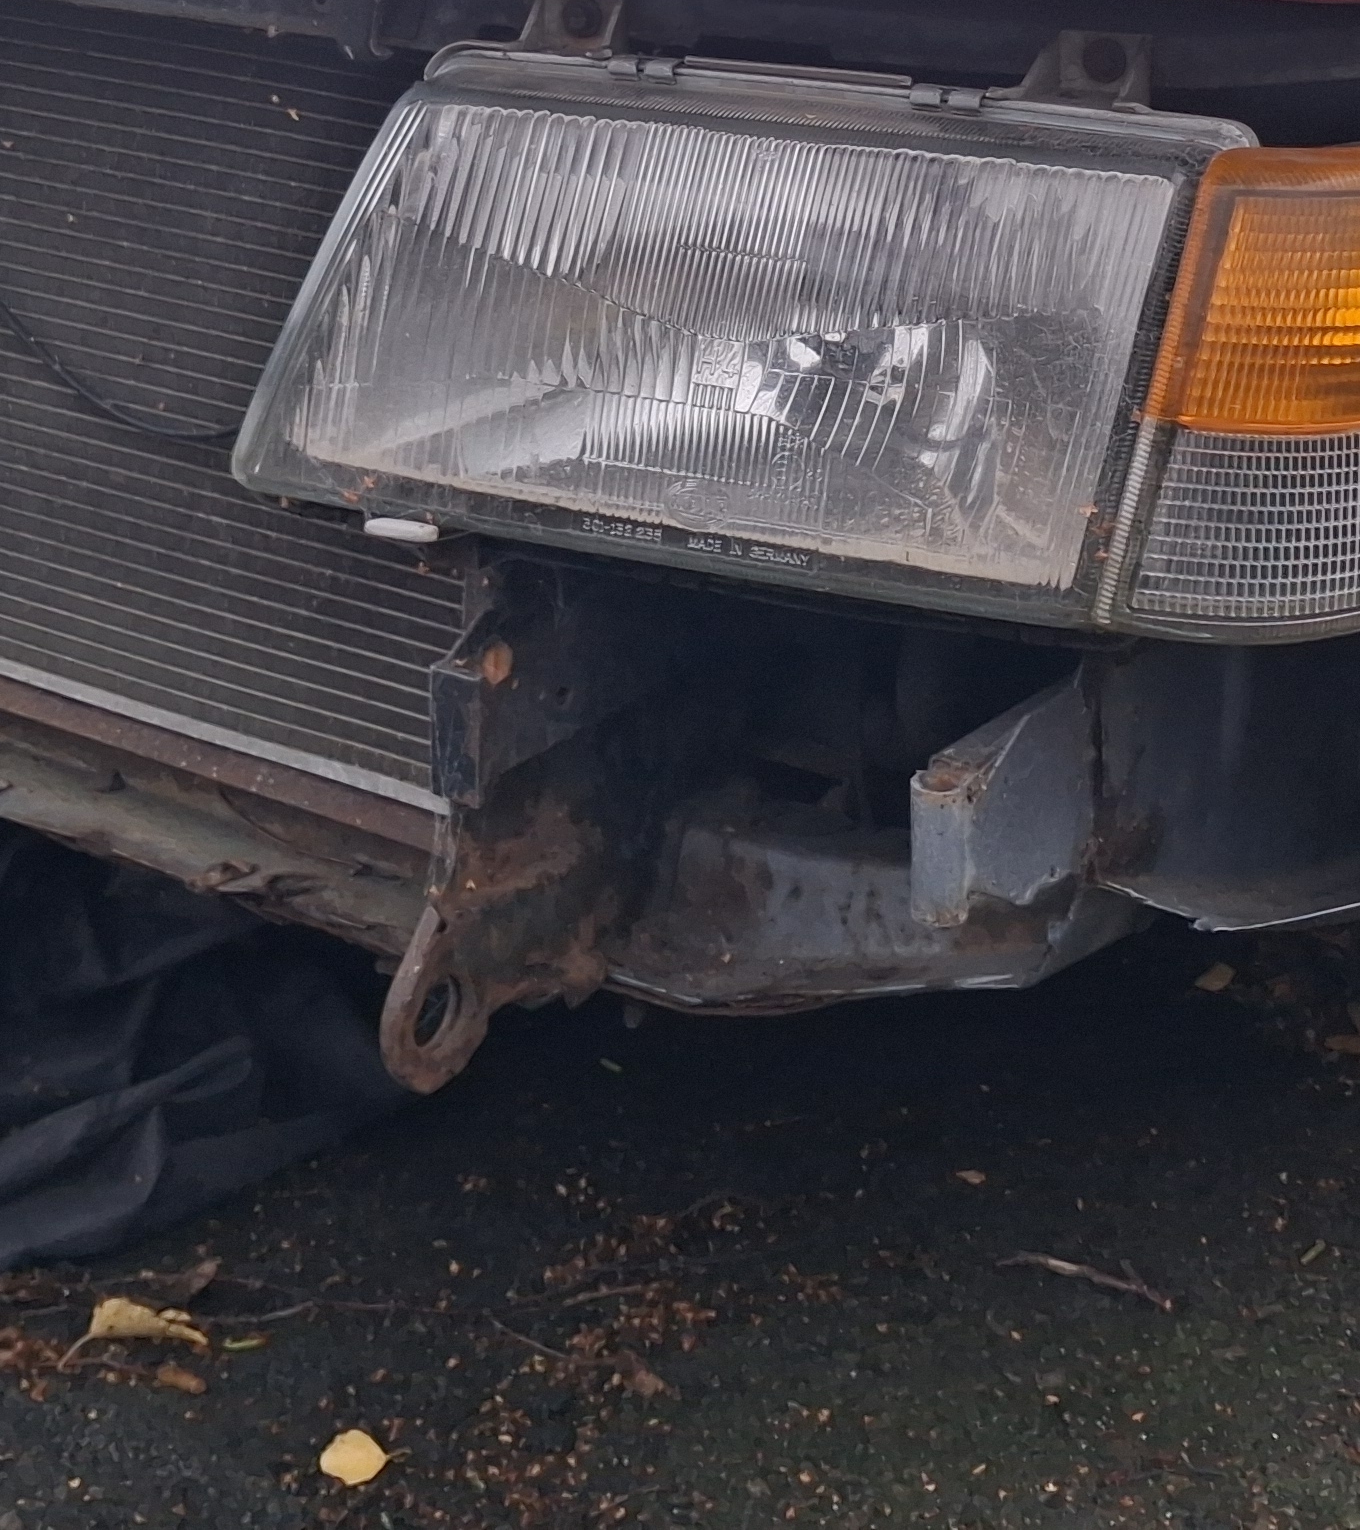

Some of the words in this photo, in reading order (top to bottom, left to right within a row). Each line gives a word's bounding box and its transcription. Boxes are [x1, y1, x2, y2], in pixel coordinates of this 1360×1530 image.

[687, 536, 722, 553] MADE
[729, 538, 743, 556] IN
[749, 545, 811, 566] GERMANY
